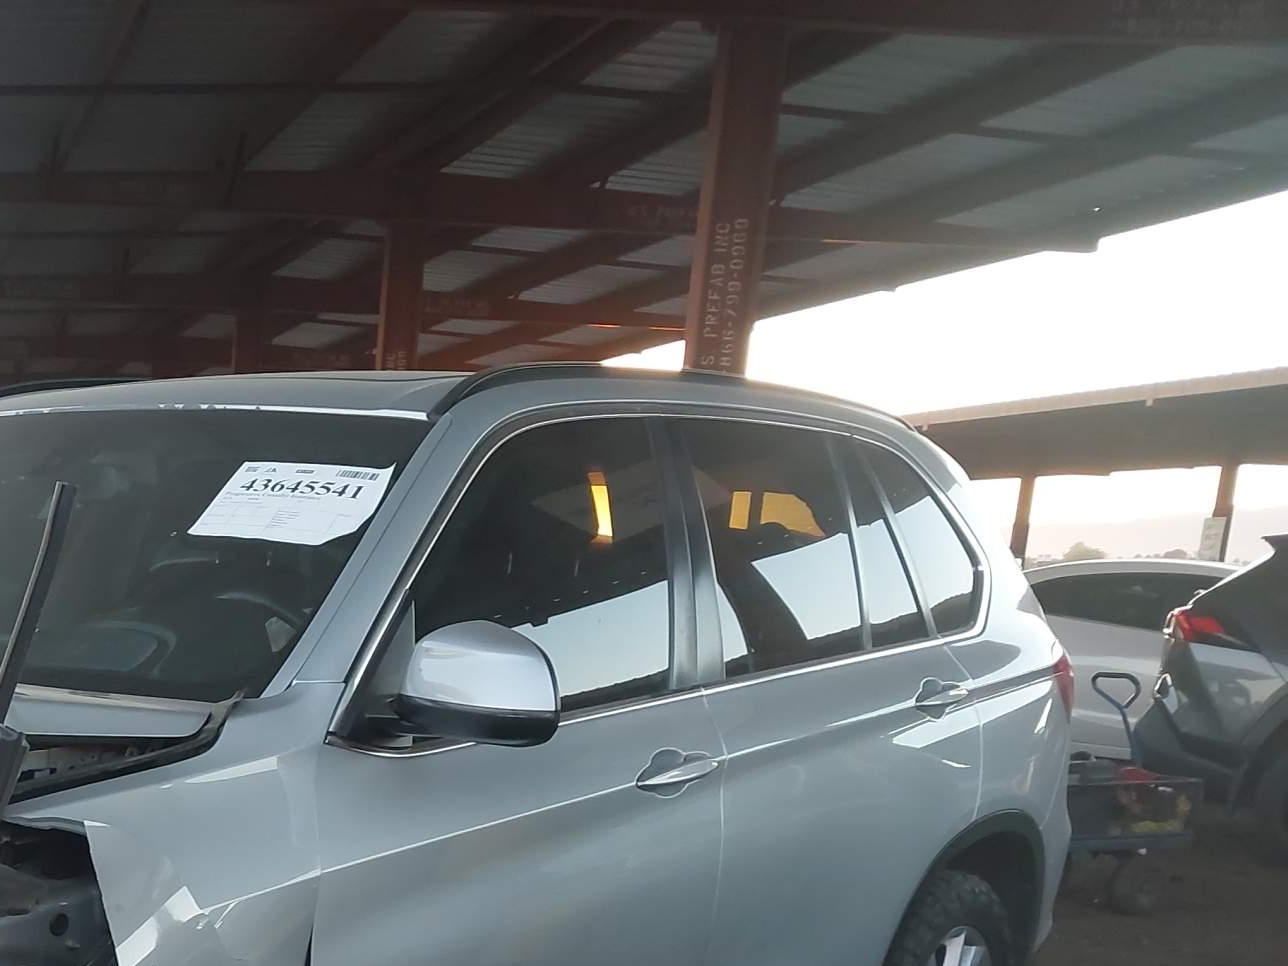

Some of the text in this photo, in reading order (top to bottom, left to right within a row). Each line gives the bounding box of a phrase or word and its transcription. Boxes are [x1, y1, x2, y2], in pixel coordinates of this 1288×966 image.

[714, 222, 730, 252] INC
[703, 263, 726, 338] PREFAB
[239, 477, 367, 500] 43645541
